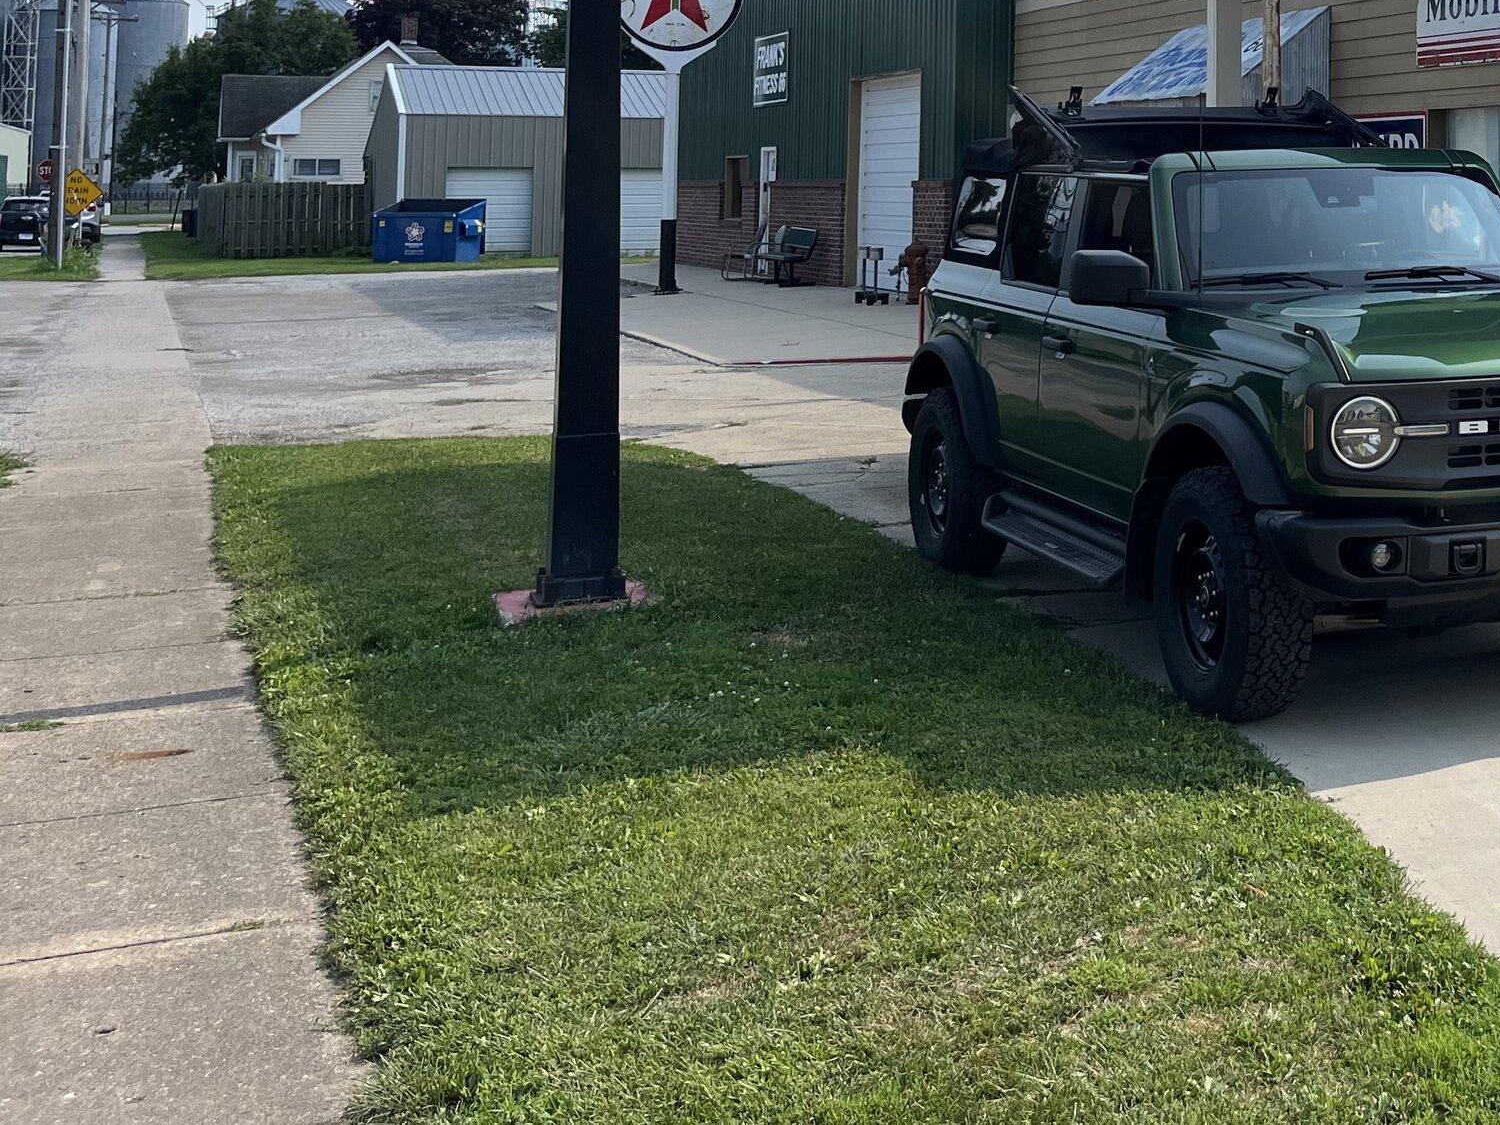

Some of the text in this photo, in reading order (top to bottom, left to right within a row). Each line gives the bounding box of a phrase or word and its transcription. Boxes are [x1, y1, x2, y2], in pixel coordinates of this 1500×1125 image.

[38, 167, 52, 175] ST
[70, 176, 83, 184] NO
[66, 186, 90, 195] RAIN
